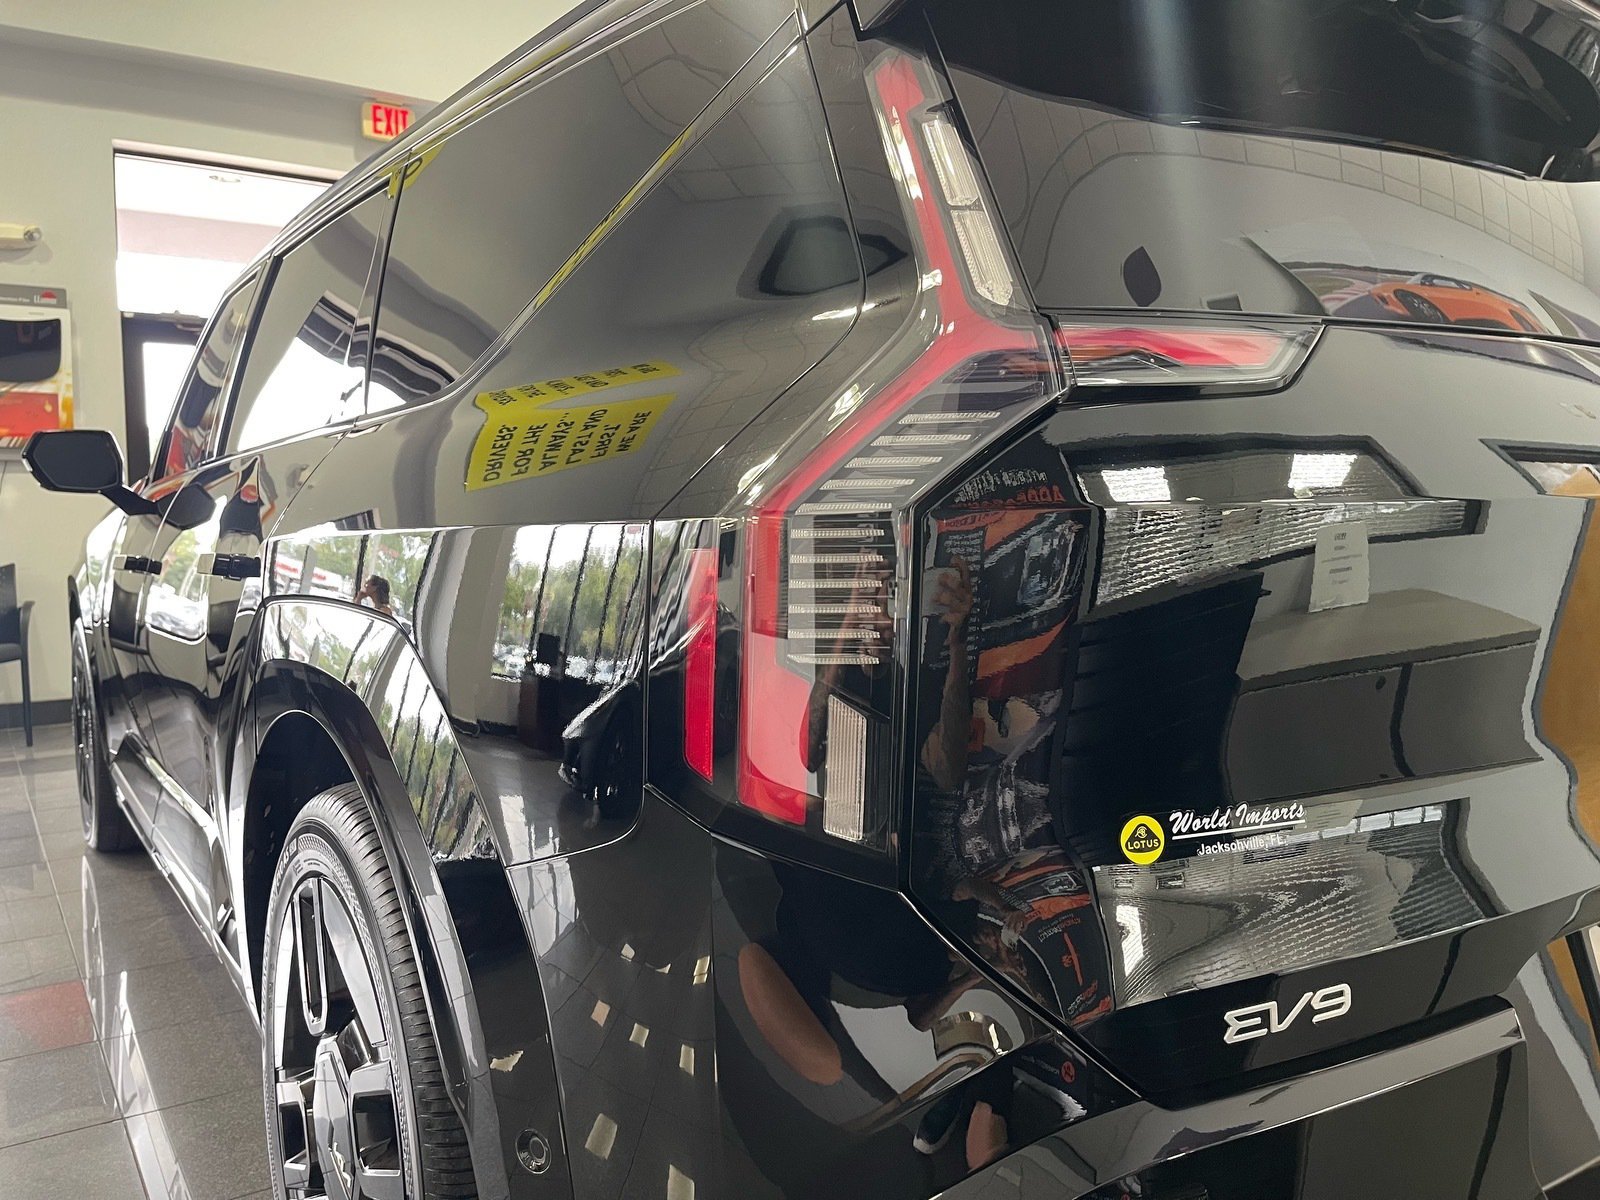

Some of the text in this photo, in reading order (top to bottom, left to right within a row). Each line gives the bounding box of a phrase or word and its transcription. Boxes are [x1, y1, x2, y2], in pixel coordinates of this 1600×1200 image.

[371, 105, 408, 136] EXIT
[1169, 801, 1305, 834] World Imports
[1127, 839, 1160, 850] LOTUS
[1223, 983, 1352, 1044] EV9
